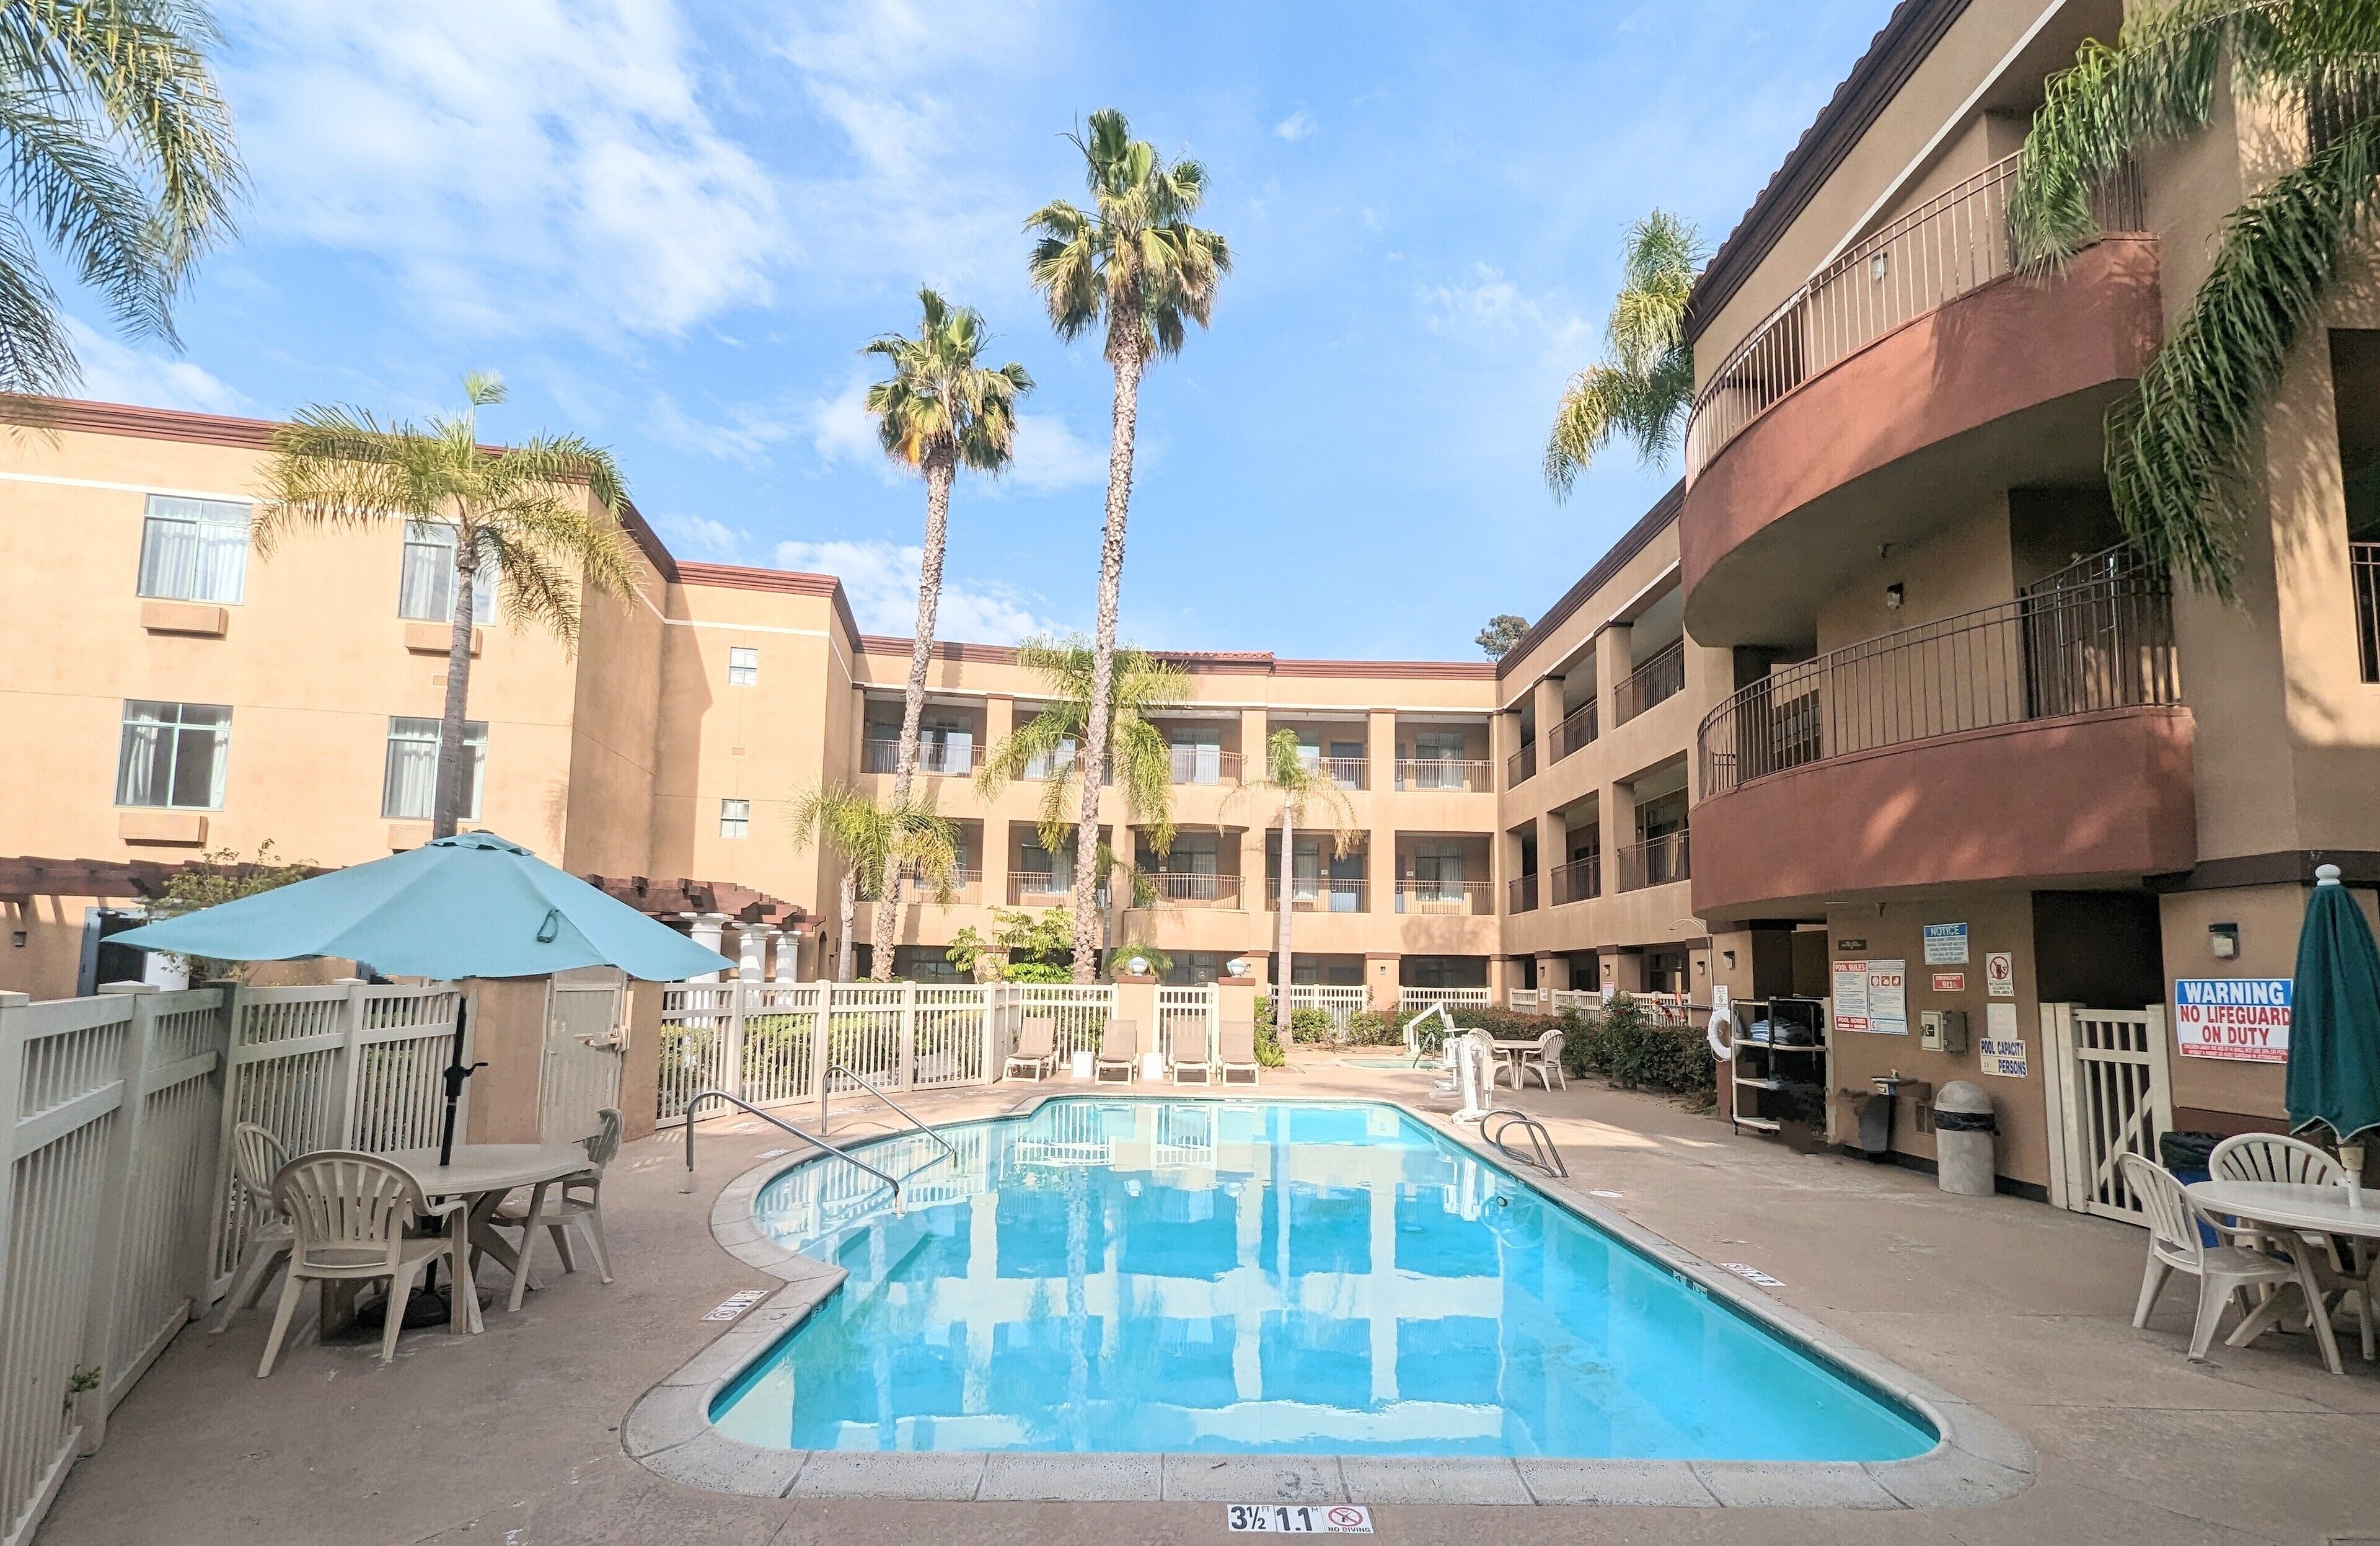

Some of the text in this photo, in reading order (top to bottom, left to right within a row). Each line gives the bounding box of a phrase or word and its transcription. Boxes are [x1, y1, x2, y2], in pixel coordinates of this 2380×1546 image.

[1930, 925, 1960, 936] NOTICE
[1849, 963, 1866, 971] RULES
[1942, 981, 1953, 989] 911
[2184, 981, 2285, 1005] WARNING
[2180, 1005, 2291, 1026] NO LIFEGUARD
[2202, 1025, 2270, 1046] ON DUTY
[1981, 1040, 2024, 1056] POOL CAPACITY
[1998, 1059, 2026, 1076] PERSONS
[1276, 1506, 1313, 1531] 1.1
